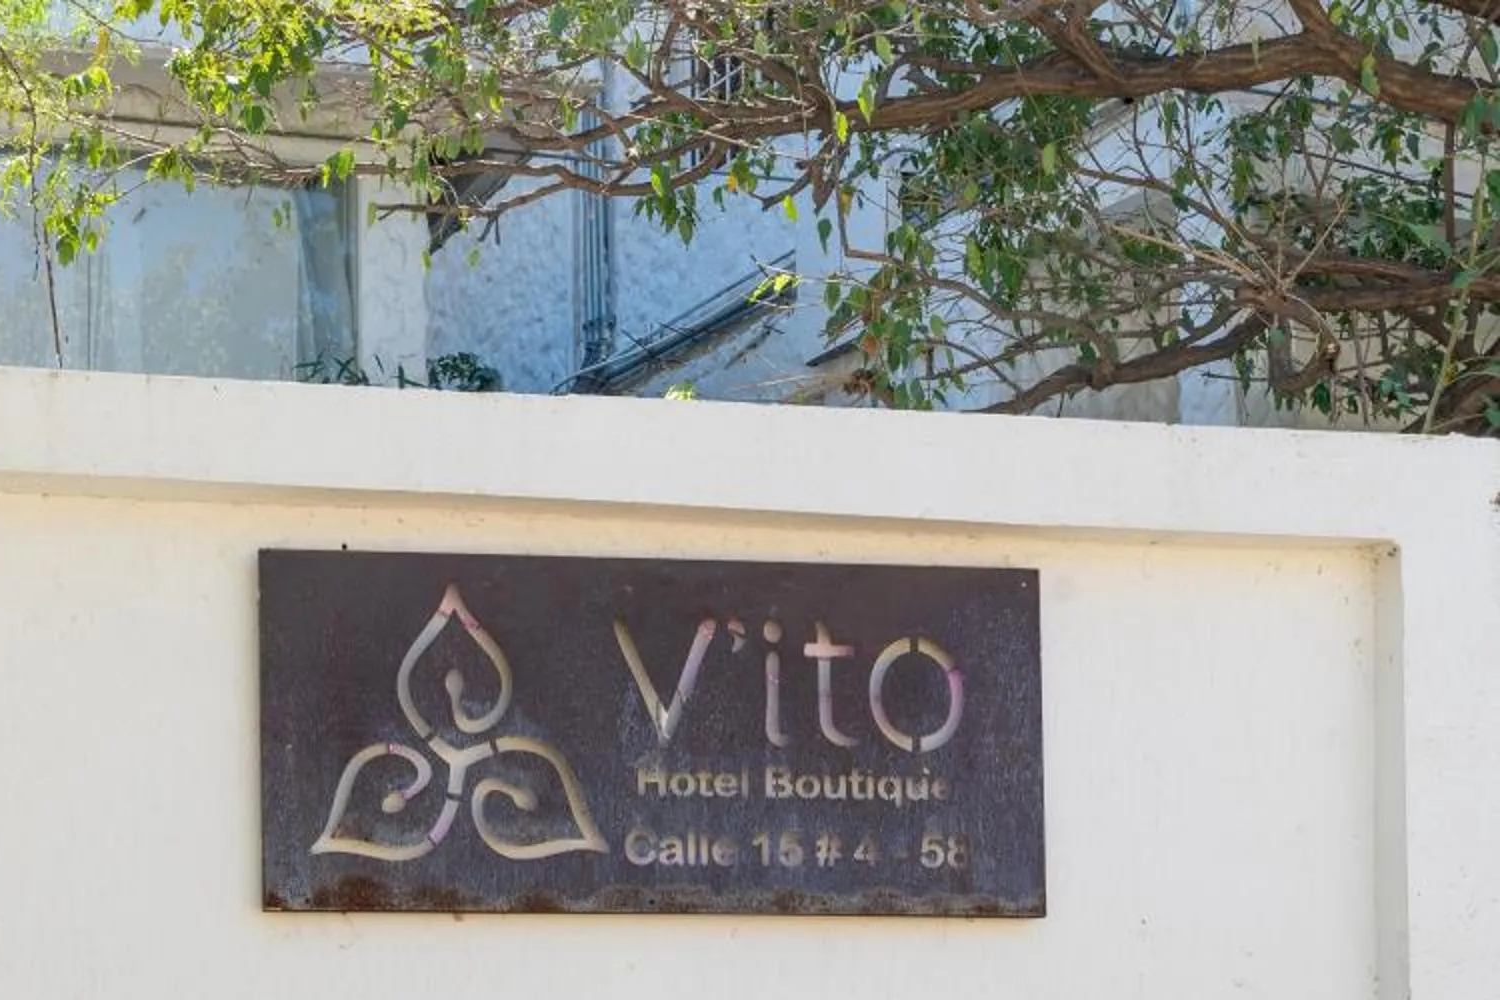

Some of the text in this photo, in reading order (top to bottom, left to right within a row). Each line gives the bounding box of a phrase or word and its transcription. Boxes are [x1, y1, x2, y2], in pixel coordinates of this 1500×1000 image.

[636, 766, 949, 808] Hotel Boutique
[624, 829, 736, 867] Calle
